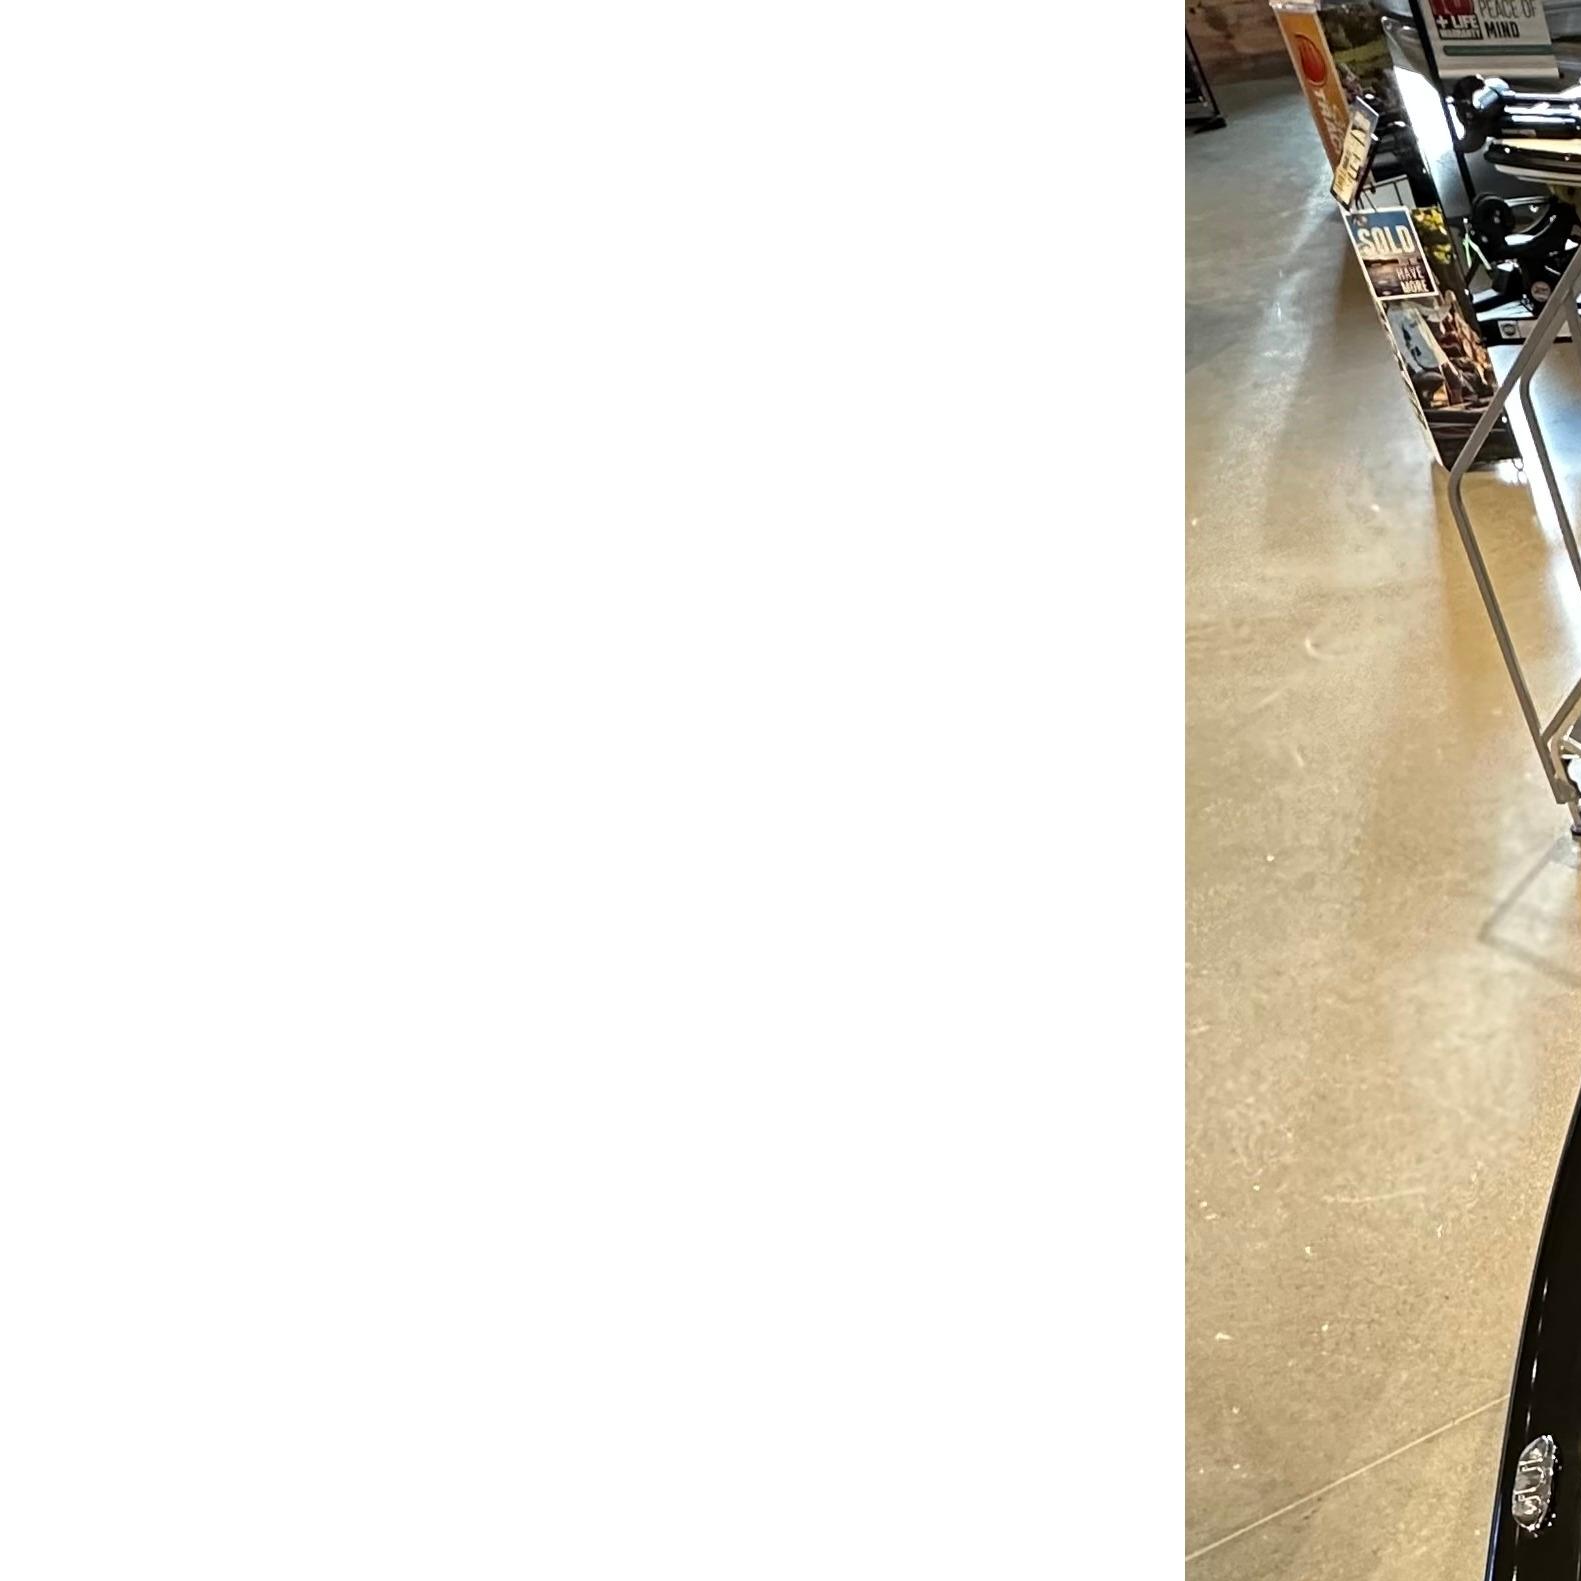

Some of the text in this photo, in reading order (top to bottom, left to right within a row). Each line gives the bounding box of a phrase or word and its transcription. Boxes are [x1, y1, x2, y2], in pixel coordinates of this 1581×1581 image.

[1450, 14, 1479, 29] LIFE
[1484, 21, 1520, 39] MIND
[1357, 224, 1415, 256] SOLD
[1396, 265, 1424, 281] HAVE
[1400, 280, 1429, 294] MORE
